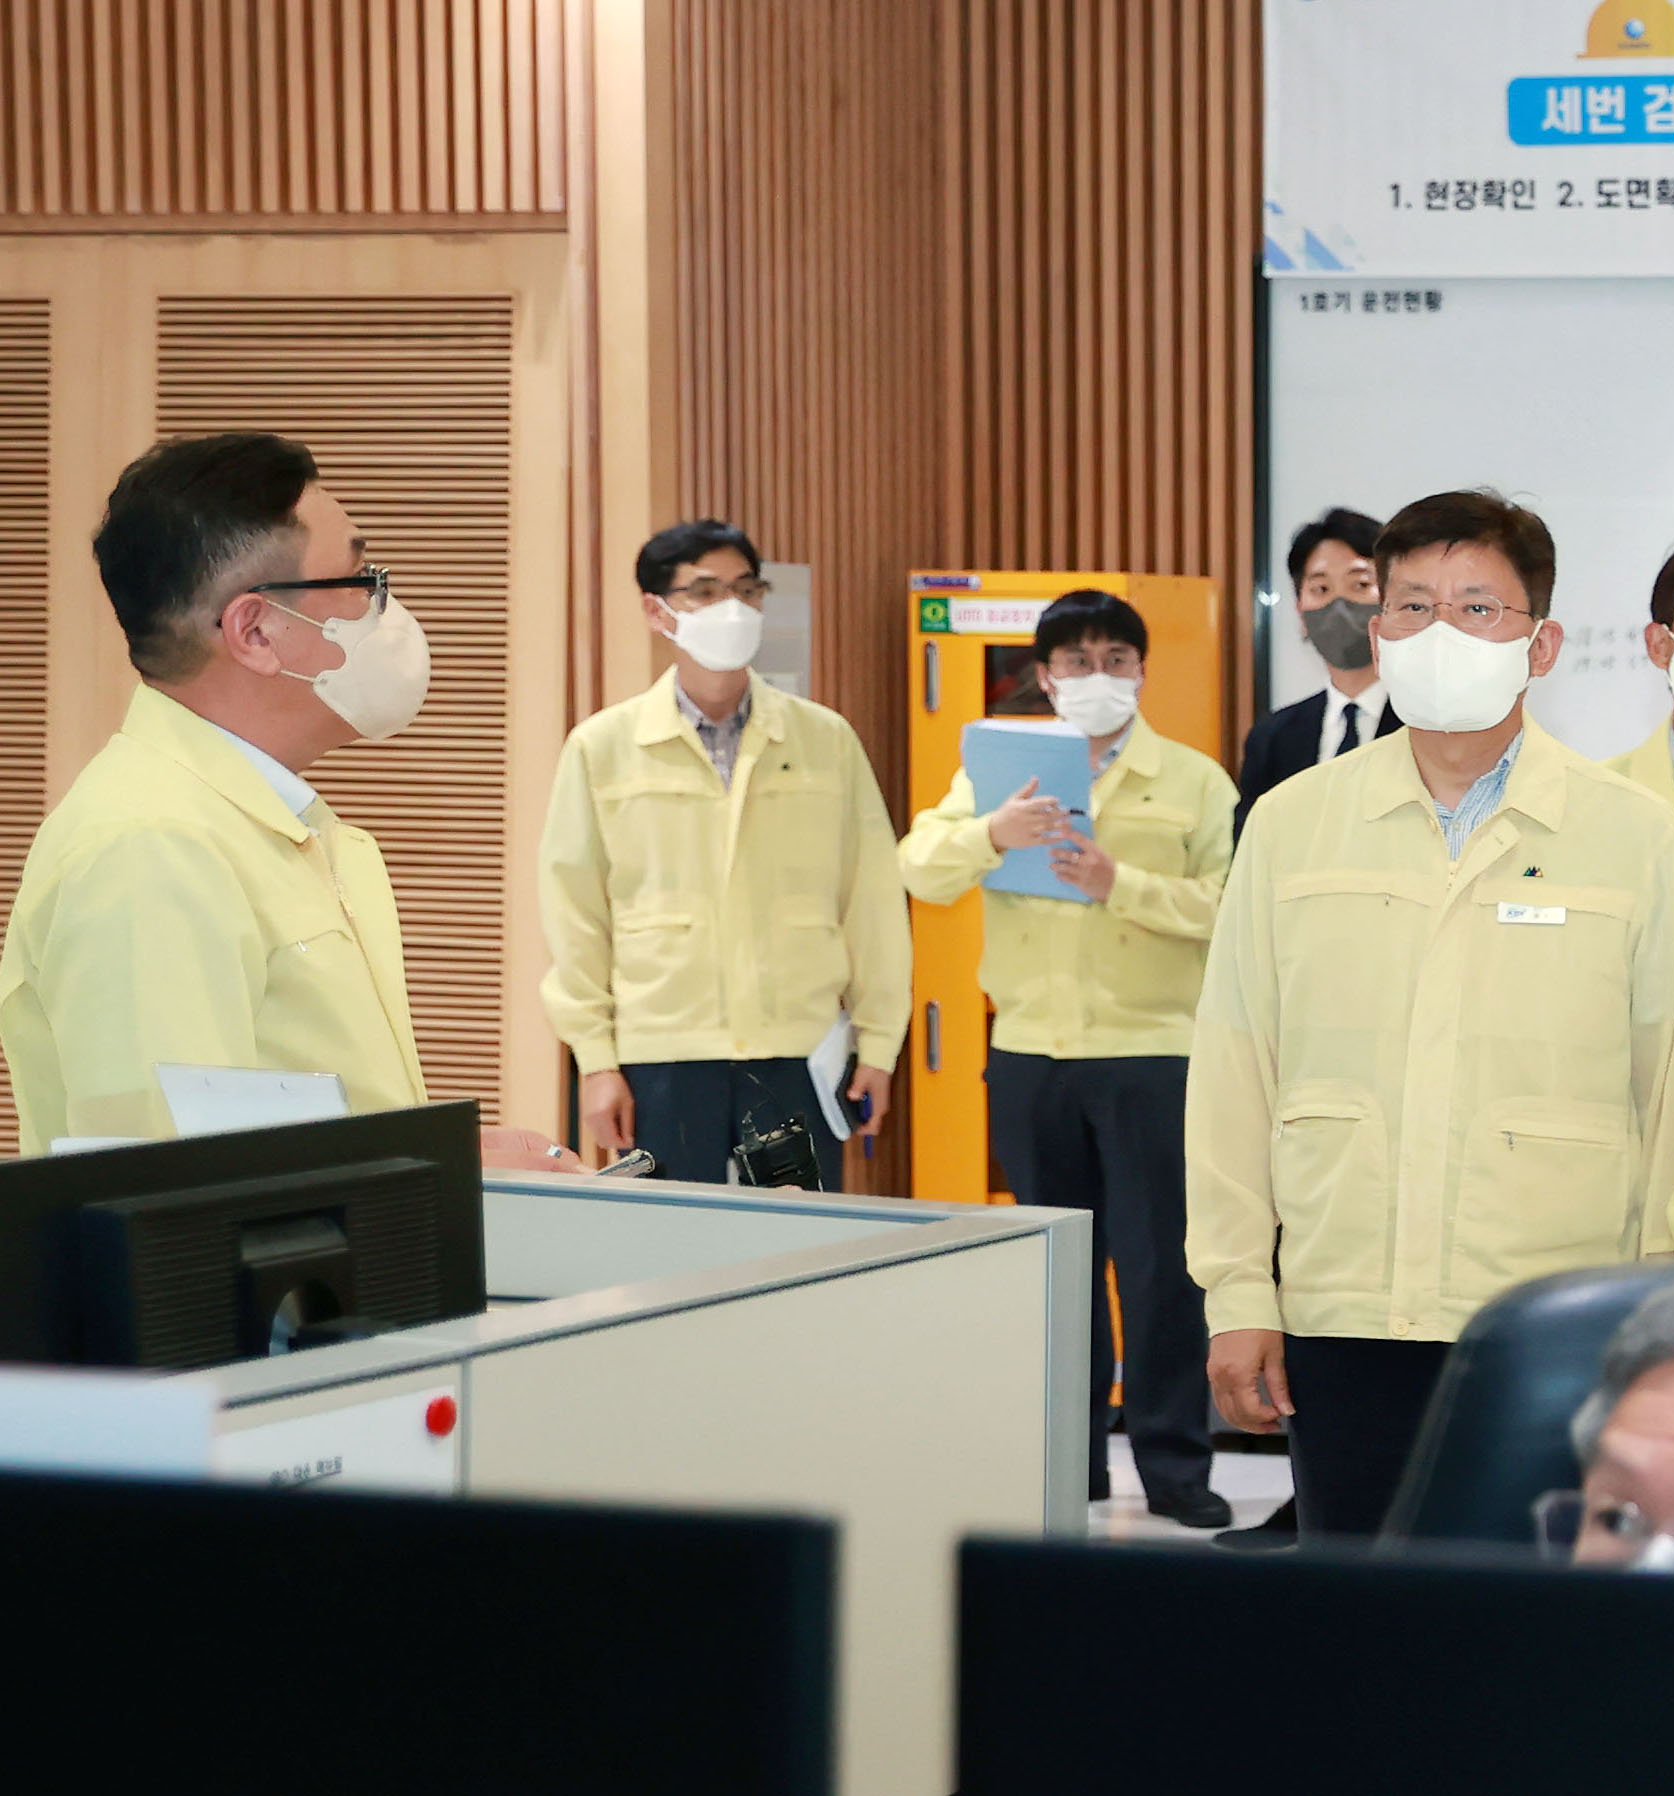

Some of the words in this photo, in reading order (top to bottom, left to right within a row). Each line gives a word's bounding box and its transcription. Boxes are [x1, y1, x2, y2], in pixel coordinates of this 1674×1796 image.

[1541, 86, 1629, 135] 세번
[1390, 183, 1412, 209] 1.
[1425, 179, 1535, 211] 현장확인
[1557, 180, 1584, 208] 2.
[1300, 291, 1351, 312] 1호기
